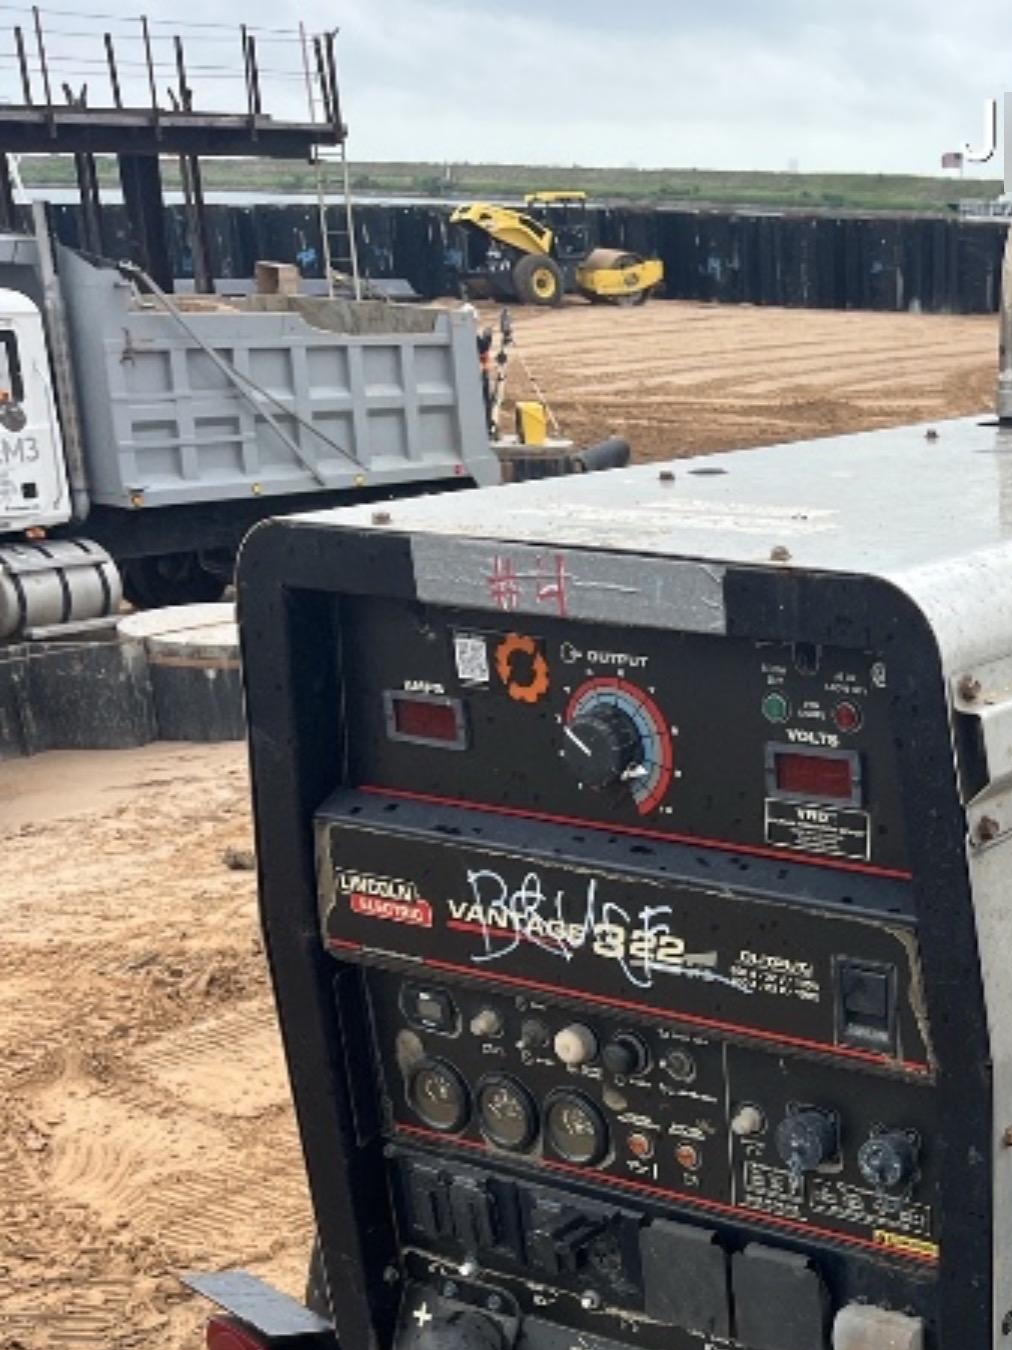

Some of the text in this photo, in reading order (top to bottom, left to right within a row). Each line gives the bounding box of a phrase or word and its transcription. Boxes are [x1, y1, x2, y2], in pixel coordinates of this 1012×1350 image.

[0, 436, 40, 464] M3
[585, 649, 649, 668] OUTPUT
[785, 727, 841, 748] VOLTS
[340, 872, 418, 901] LINCOLN
[447, 899, 585, 944] VANTAGE
